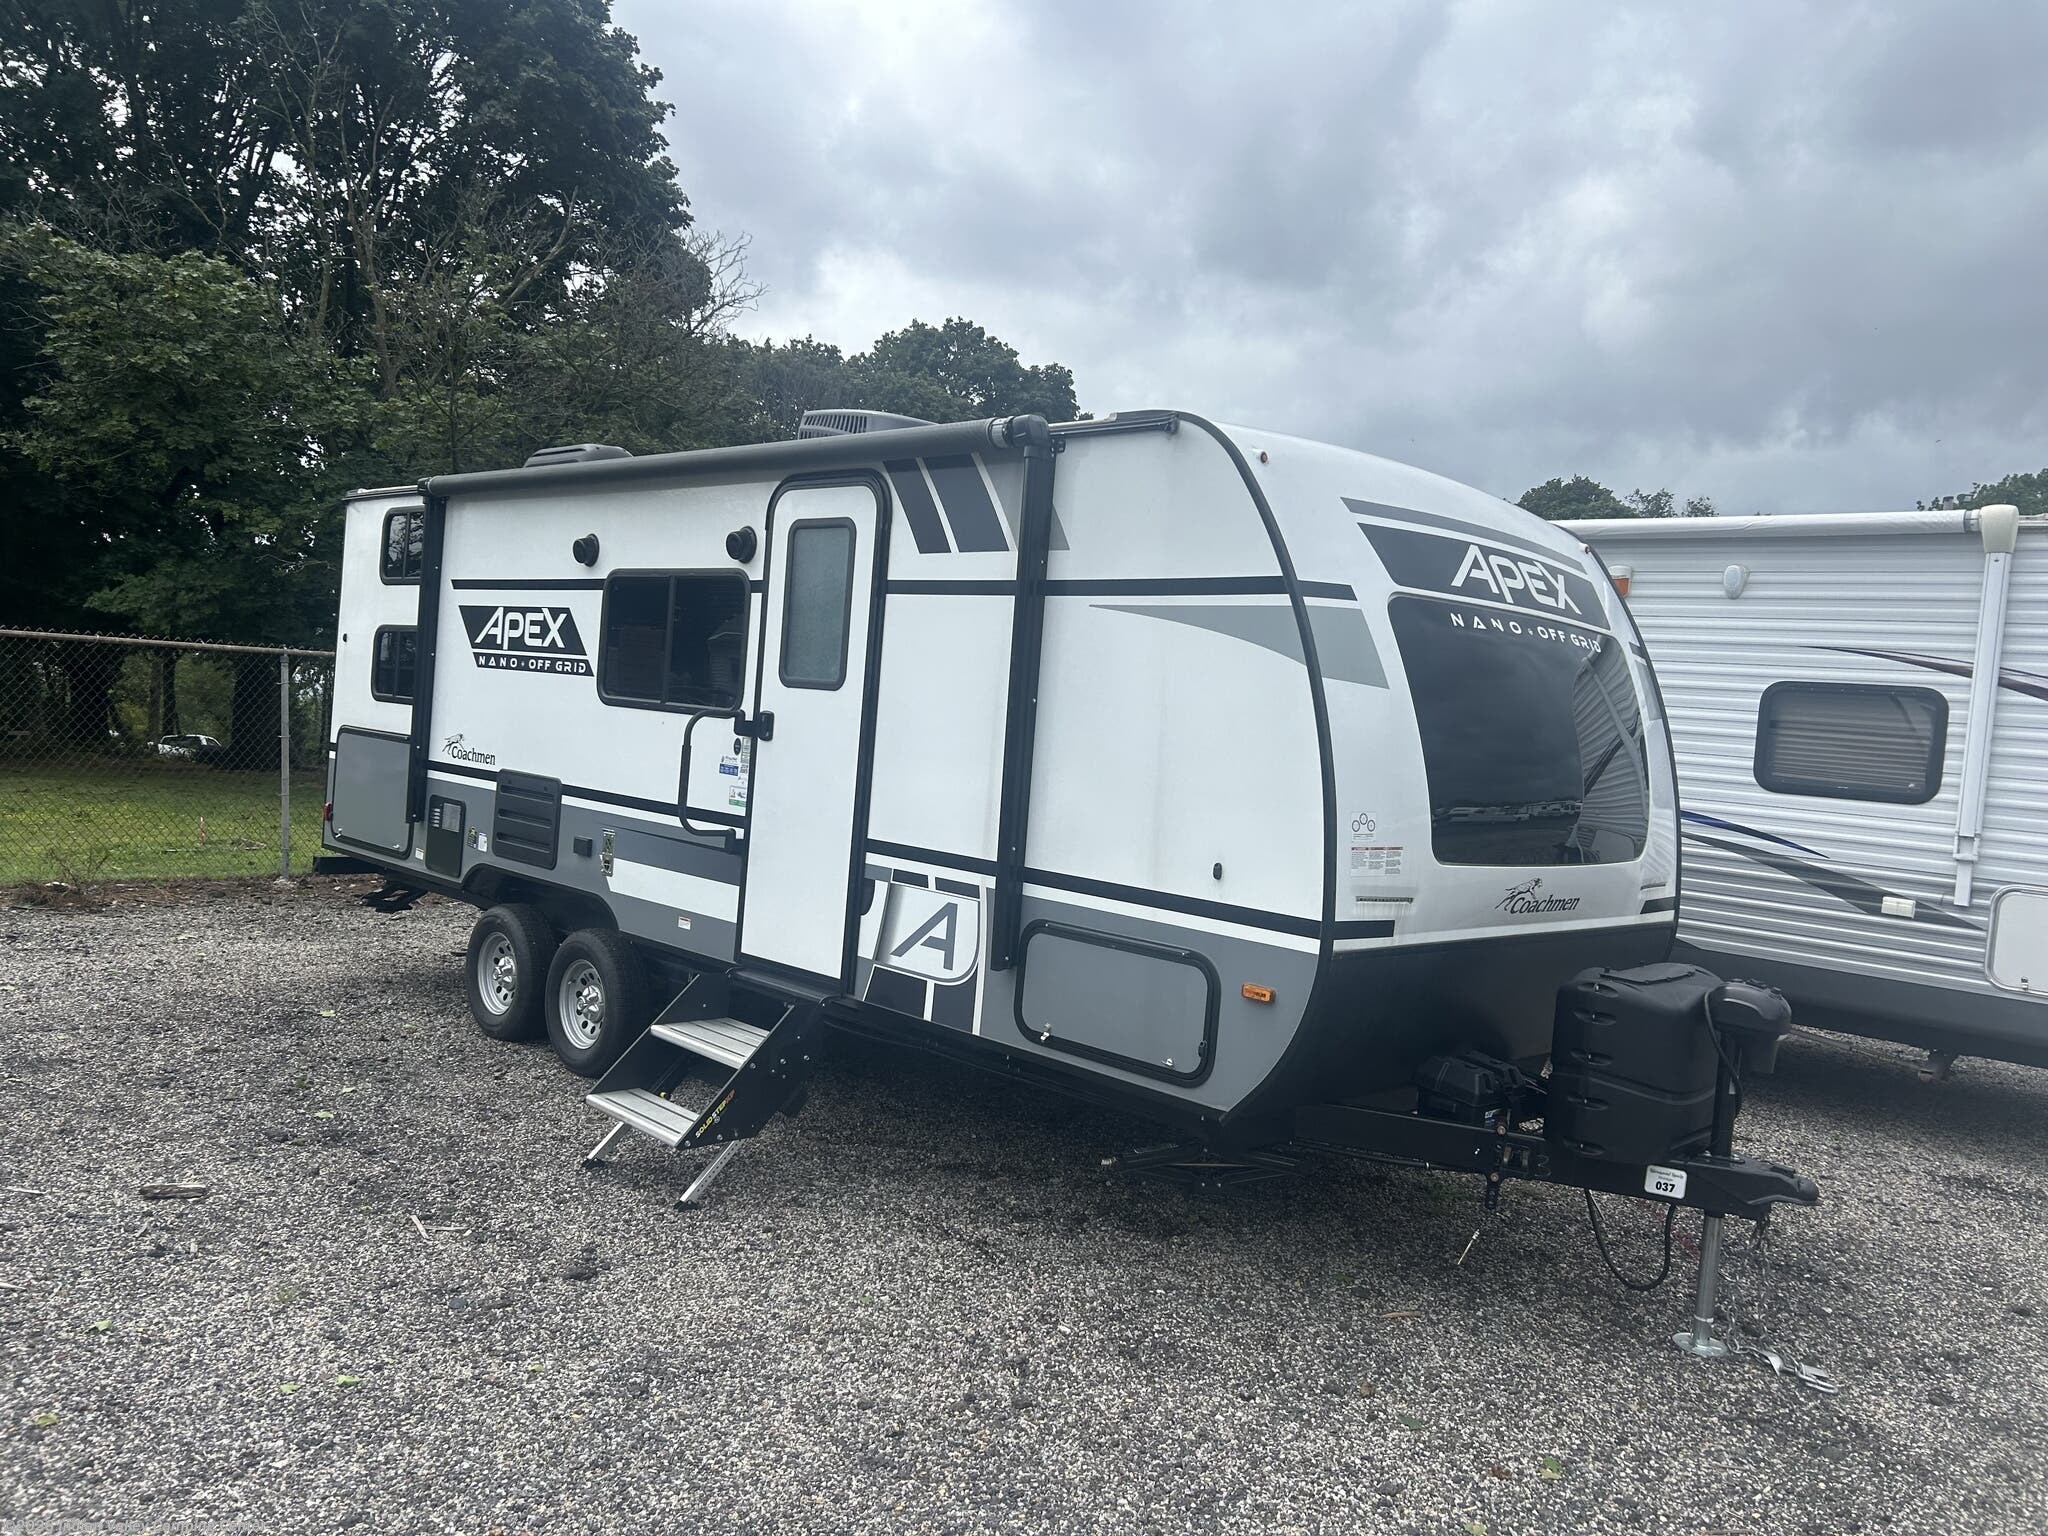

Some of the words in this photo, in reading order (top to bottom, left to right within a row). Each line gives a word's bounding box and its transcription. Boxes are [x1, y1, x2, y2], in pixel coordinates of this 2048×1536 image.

[1450, 544, 1583, 616] APEX
[474, 606, 568, 651] APEX
[1450, 612, 1523, 635] NANO
[1536, 625, 1567, 644] OFF
[1570, 633, 1602, 653] GRID
[478, 655, 518, 668] NANO
[528, 658, 552, 671] OFF
[555, 660, 587, 673] GRID
[451, 746, 497, 766] Coachmen
[1510, 894, 1581, 915] Coachmen
[1655, 1180, 1676, 1193] 037
